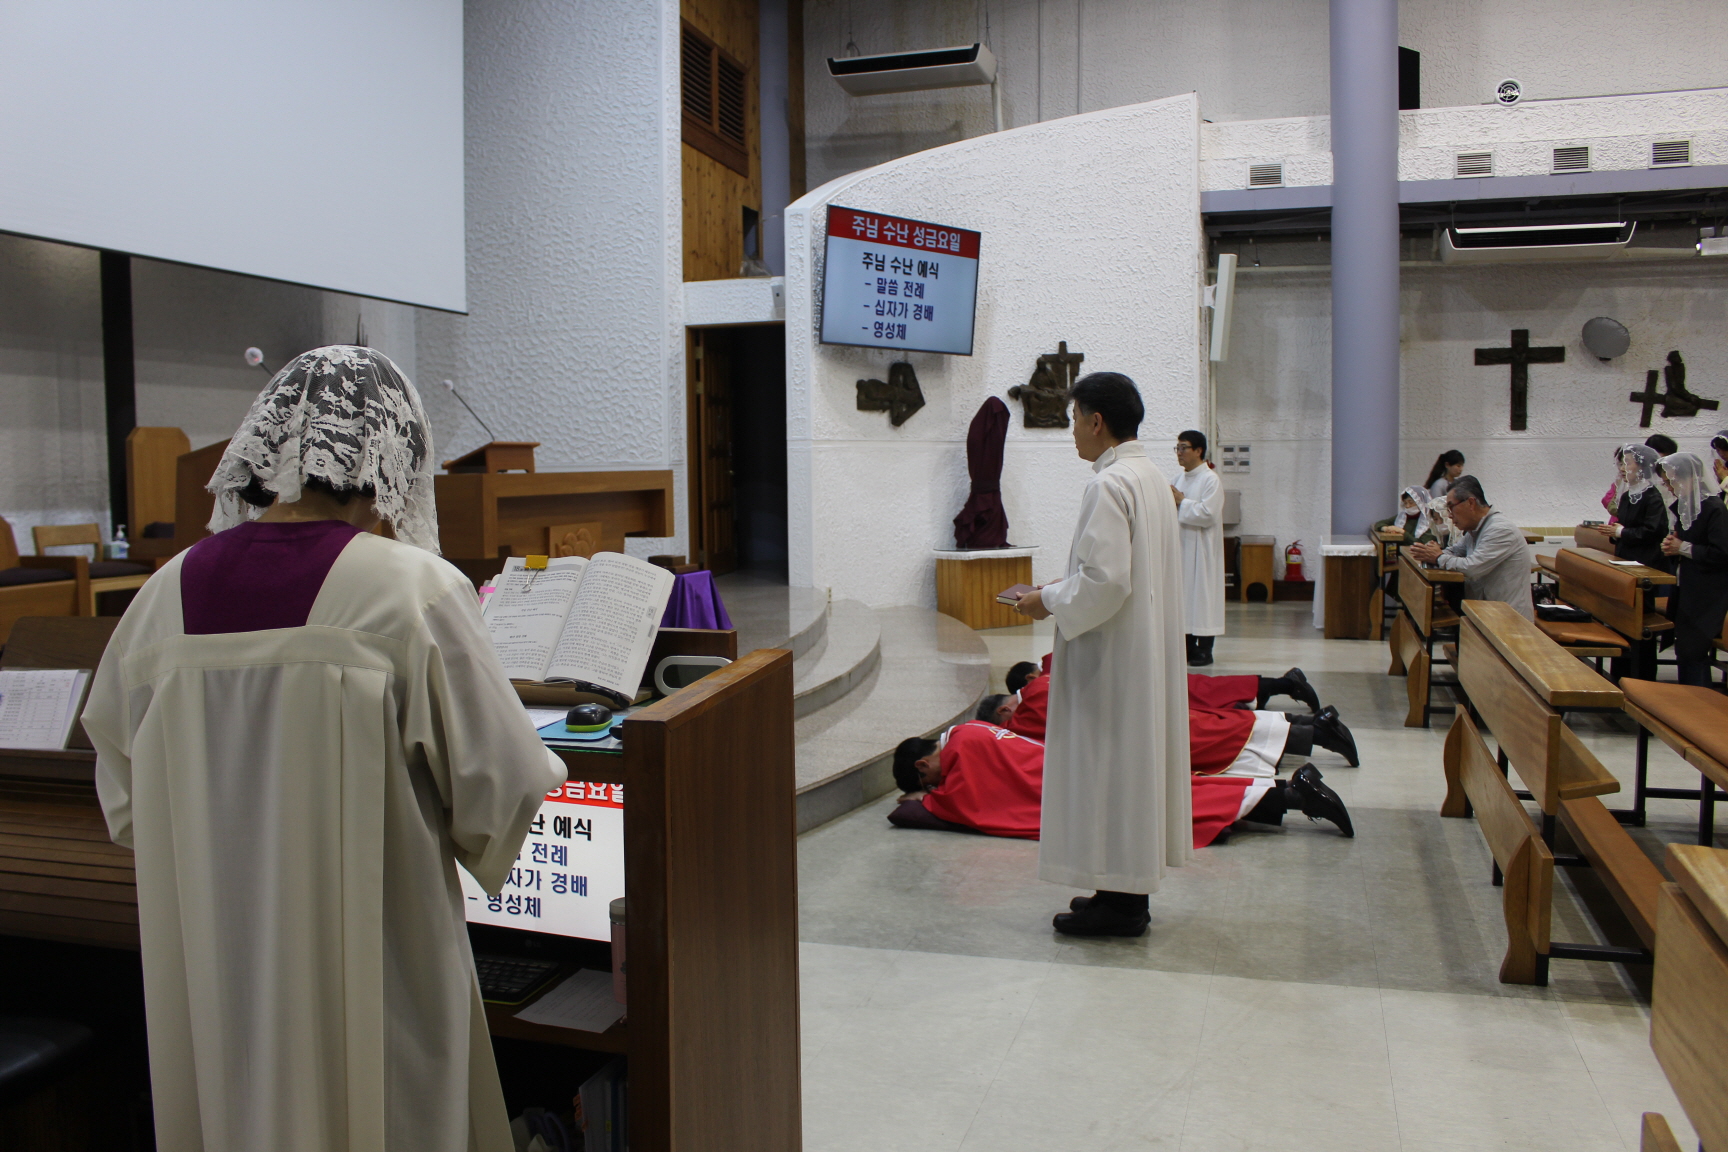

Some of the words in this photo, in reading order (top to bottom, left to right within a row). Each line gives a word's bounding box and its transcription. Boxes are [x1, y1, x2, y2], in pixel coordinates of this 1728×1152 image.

[852, 215, 879, 239] 주님
[883, 221, 909, 244] 수난
[913, 226, 961, 252] 성금요일
[862, 252, 885, 272] 주님
[890, 256, 913, 276] 수난
[917, 260, 939, 279] 예식
[876, 277, 898, 296] 말씀
[903, 281, 925, 299] 전례
[874, 299, 908, 319] 십자가
[912, 304, 934, 321] 경배
[873, 321, 907, 340] 영성체
[528, 813, 545, 836] 난
[553, 815, 592, 841] 예식
[531, 842, 568, 867] 전례
[505, 867, 542, 891] 자가
[551, 872, 588, 897] 경배
[486, 892, 541, 918] 영성체
